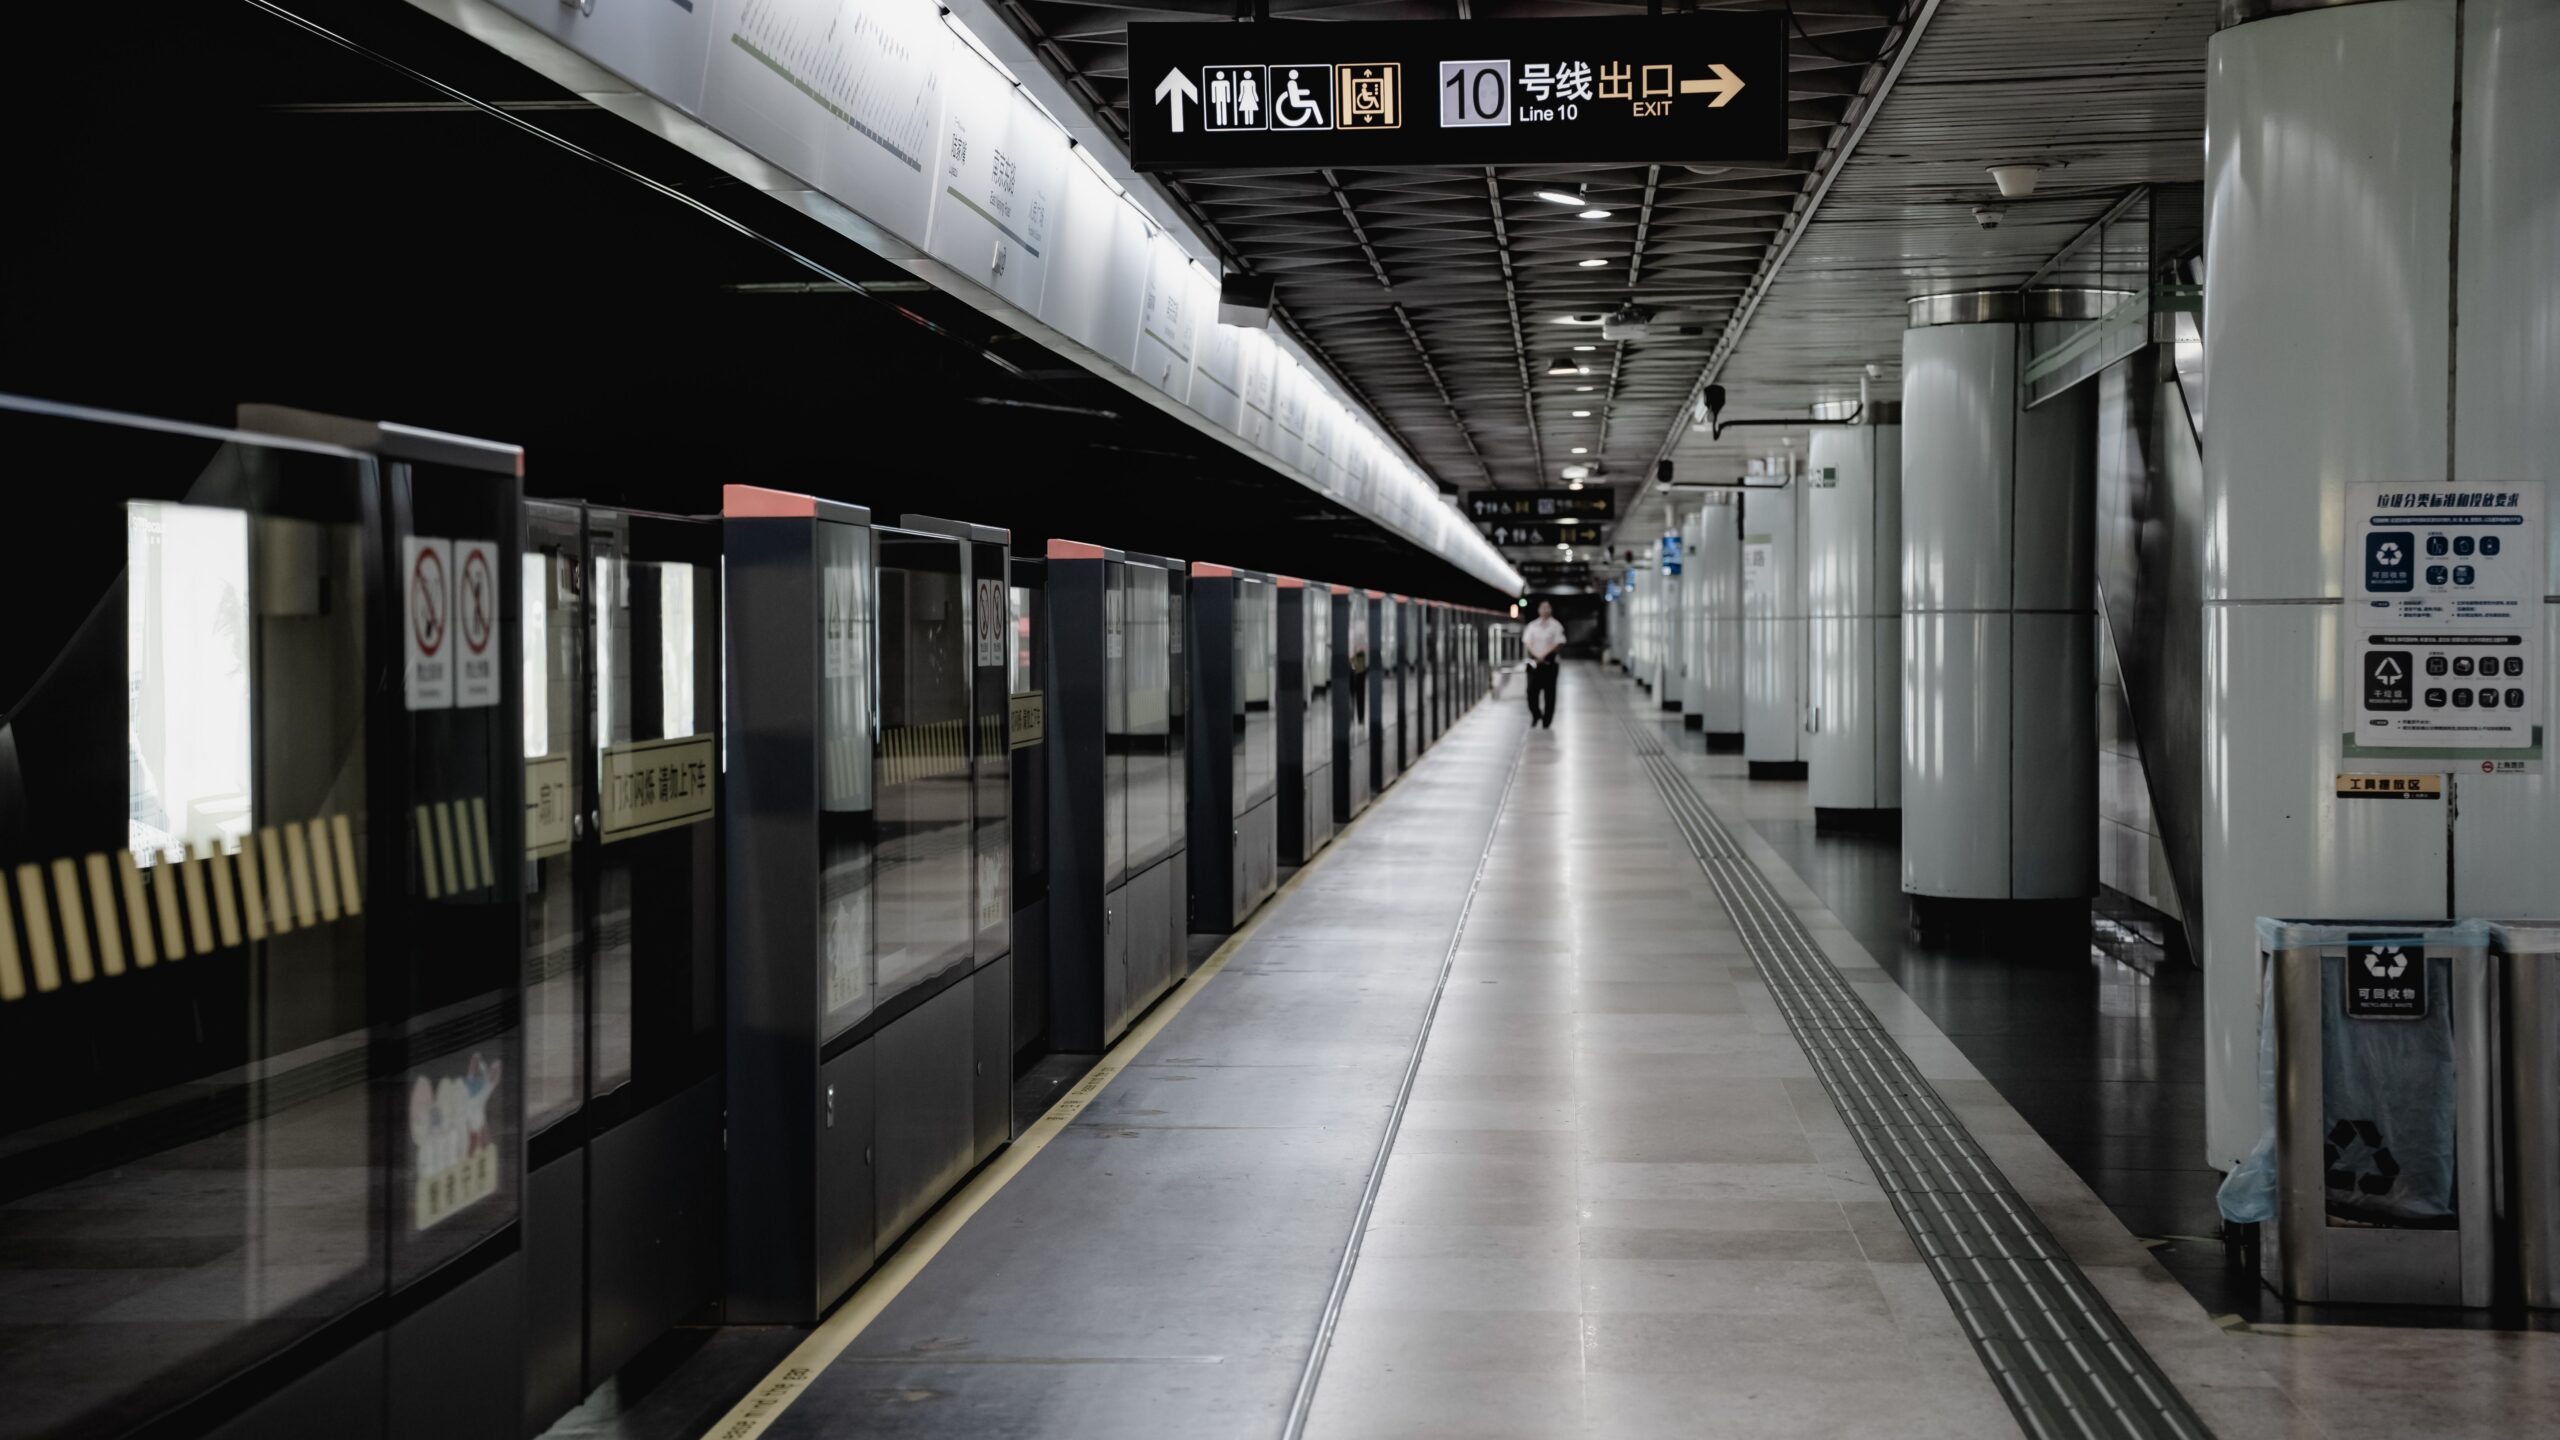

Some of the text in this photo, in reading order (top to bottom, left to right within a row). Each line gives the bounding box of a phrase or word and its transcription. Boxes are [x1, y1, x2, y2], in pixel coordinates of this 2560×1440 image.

[1446, 61, 1672, 119] 10 号线 出口
[1520, 103, 1578, 121] Line 10
[1633, 100, 1672, 117] EXIT
[658, 760, 706, 803] 请勿上下车
[2358, 987, 2416, 1000] 可回收物
[782, 1368, 810, 1381] gap
